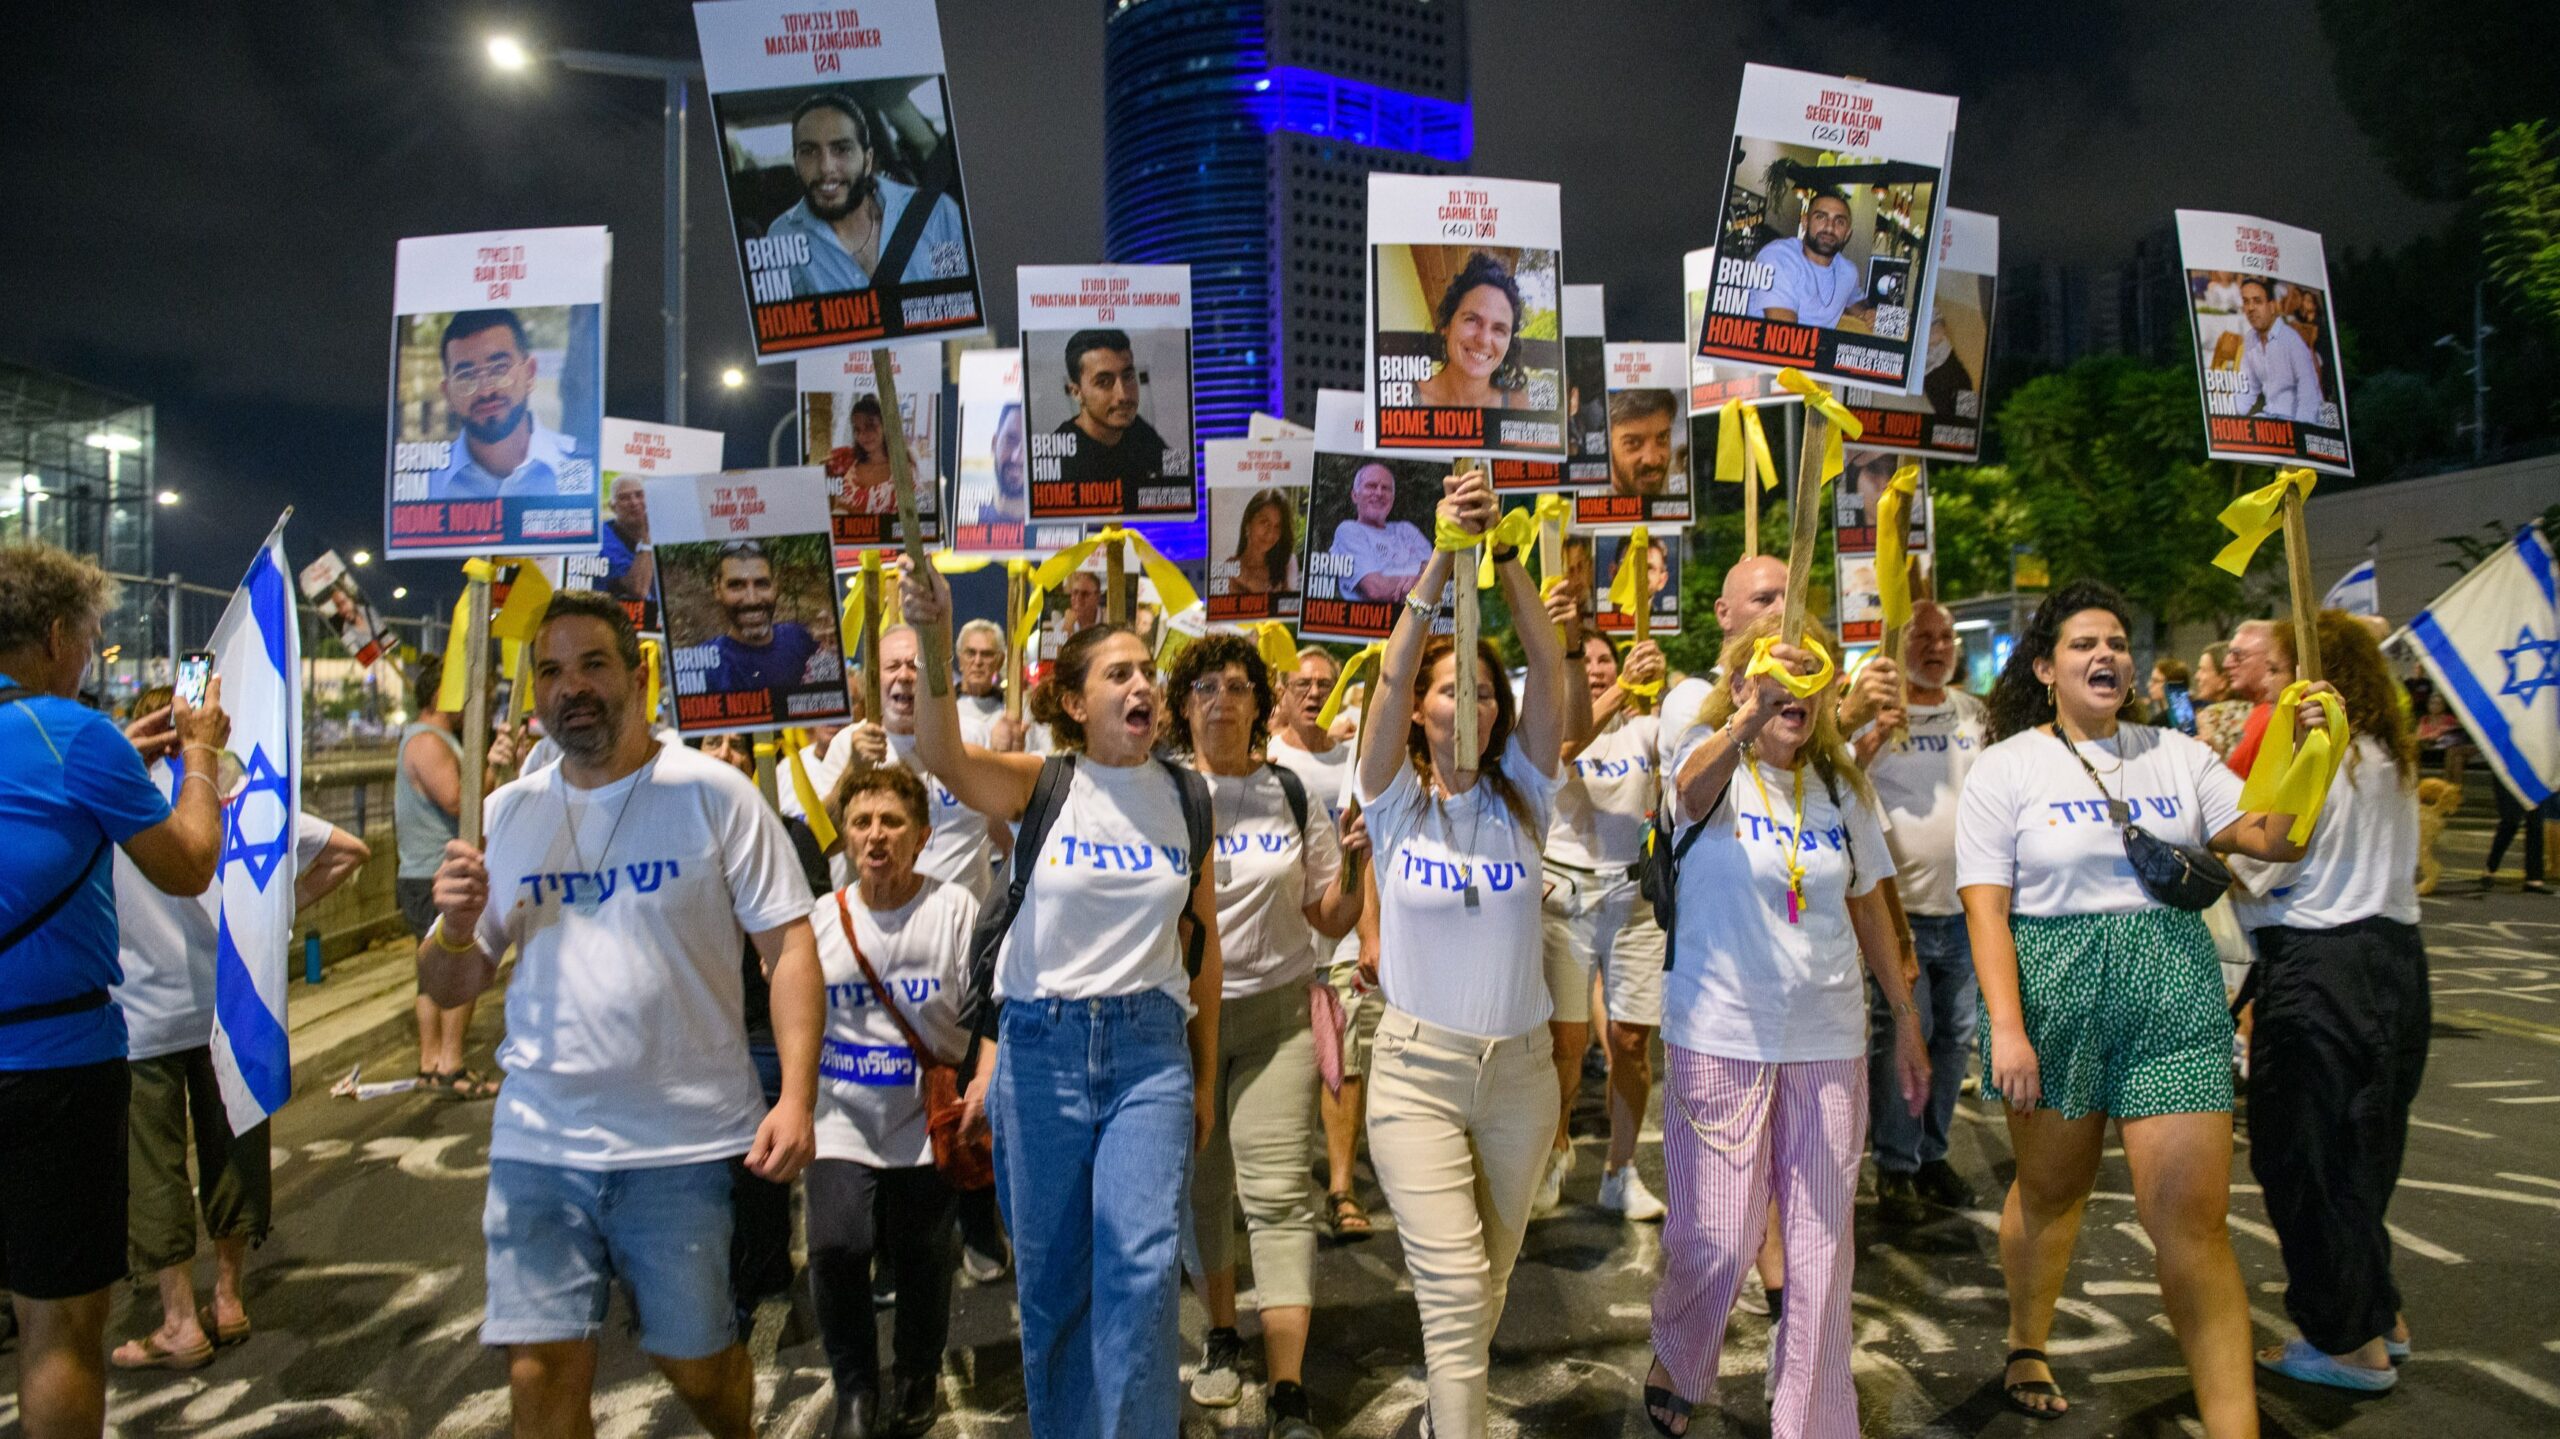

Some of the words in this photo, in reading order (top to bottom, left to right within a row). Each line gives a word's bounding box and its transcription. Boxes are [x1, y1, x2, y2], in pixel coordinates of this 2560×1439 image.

[765, 34, 808, 56] MATAN
[811, 28, 881, 52] ZANGAUKER
[814, 52, 841, 75] (24)
[1805, 104, 1840, 124] SEGEV
[1841, 110, 1882, 131] KALFON
[1812, 124, 1845, 144] (26)
[1439, 206, 1476, 220] CARMEL
[1481, 207, 1499, 221] GAT
[1442, 223, 1473, 238] (40)
[745, 233, 811, 271] BRING
[1717, 256, 1775, 291] BRING
[751, 269, 794, 304] HIM
[1030, 294, 1077, 308] YONATHAN
[1079, 293, 1130, 307] MORDECHAI
[1132, 291, 1181, 306] SAMERANO
[1711, 285, 1750, 316] HIM
[756, 301, 818, 339] HOME
[820, 289, 881, 330] NOW!
[1098, 308, 1115, 322] (21)
[1706, 316, 1759, 349] HOME
[1763, 323, 1819, 358] NOW!
[1379, 355, 1431, 381] BRING
[1835, 353, 1873, 371] FAMILIES
[1873, 359, 1904, 376] FORUM
[2205, 370, 2249, 393] BRING
[1380, 382, 1413, 407] HER
[2207, 392, 2236, 415] HIM
[1380, 410, 1429, 436] HOME
[1434, 408, 1483, 436] NOW!
[1853, 409, 1881, 434] OME
[1885, 412, 1921, 438] NOW!
[2211, 418, 2252, 442] HOME
[2255, 420, 2294, 446] NOW!
[395, 441, 451, 471] BRING
[1032, 433, 1077, 457] BRING
[1032, 457, 1062, 481] HIM
[1494, 461, 1525, 480] HOME
[1528, 461, 1560, 480] NOW!
[394, 471, 429, 501] HIM
[1033, 482, 1076, 506] HOME
[1079, 478, 1122, 505] NOW!
[393, 503, 445, 533] HOME
[450, 497, 503, 532] NOW!
[1578, 497, 1610, 515] HOME
[1611, 496, 1642, 515] NOW!
[568, 556, 610, 577] BRING
[1211, 560, 1241, 577] BRING
[1310, 552, 1354, 577] BRING
[1210, 578, 1229, 595] HER
[1307, 575, 1336, 599] HIM
[1306, 600, 1345, 624] HOME
[1351, 603, 1392, 628] NOW!
[673, 645, 721, 671] BRING
[676, 670, 707, 695] HIM
[679, 694, 723, 719] HOME
[726, 687, 772, 715] NOW!
[2146, 796, 2183, 819] יש
[1257, 833, 1292, 853] יש
[1161, 845, 1190, 876] ש
[626, 860, 681, 894] יש
[1482, 862, 1527, 891] יש
[901, 978, 941, 1003] יש
